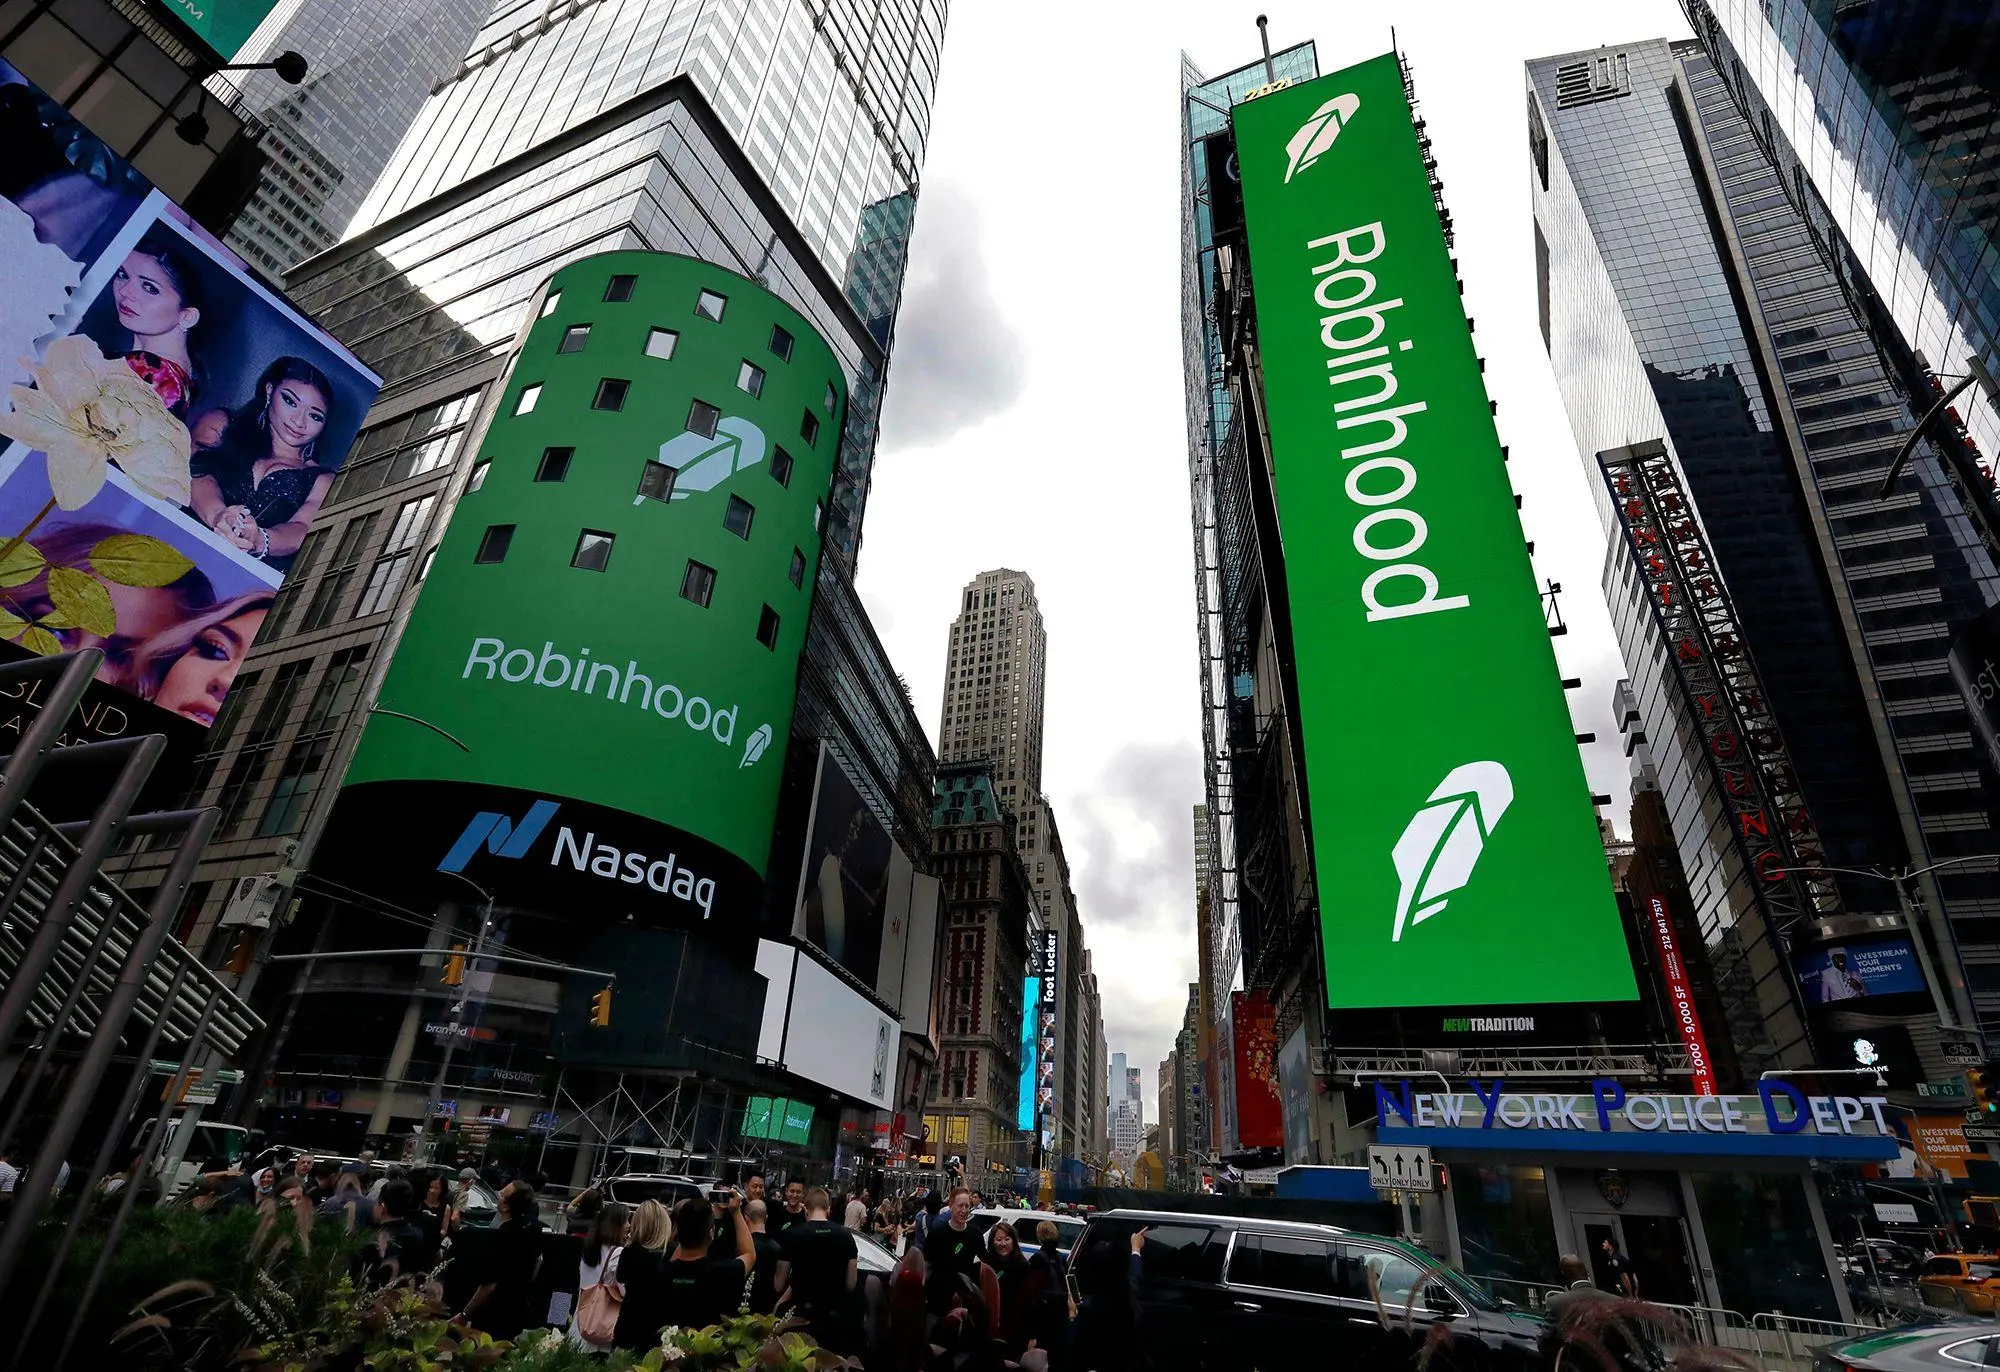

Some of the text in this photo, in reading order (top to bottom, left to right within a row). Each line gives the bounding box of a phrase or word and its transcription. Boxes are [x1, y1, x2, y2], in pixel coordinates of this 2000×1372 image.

[1307, 221, 1470, 622] Robinhood
[1614, 471, 1674, 608] ERNST
[1697, 694, 1785, 882] YOUNG
[462, 638, 738, 746] Robinhood
[551, 826, 716, 920] Nasdaq
[1652, 899, 1673, 950] 212 841 7517
[1854, 948, 1908, 962] LIVESTREAM
[1857, 958, 1881, 967] YOUR
[1044, 933, 1056, 1003] Foot Locker
[1859, 963, 1903, 975] MOMENTS
[1674, 985, 1687, 999] SF
[1680, 1001, 1696, 1034] 9,000
[424, 1023, 468, 1036] brand
[1690, 1043, 1707, 1076] 3,000
[1946, 1056, 1982, 1065] BIKE LANE
[493, 1068, 535, 1087] Nasdaq
[1928, 1085, 1938, 1095] W
[1942, 1085, 1954, 1096] 43
[1373, 1078, 1888, 1136] NEW YORK POLICE DEPT
[1967, 1129, 1985, 1137] ONE
[1372, 1176, 1430, 1188] ONLY ONLY ONLY
